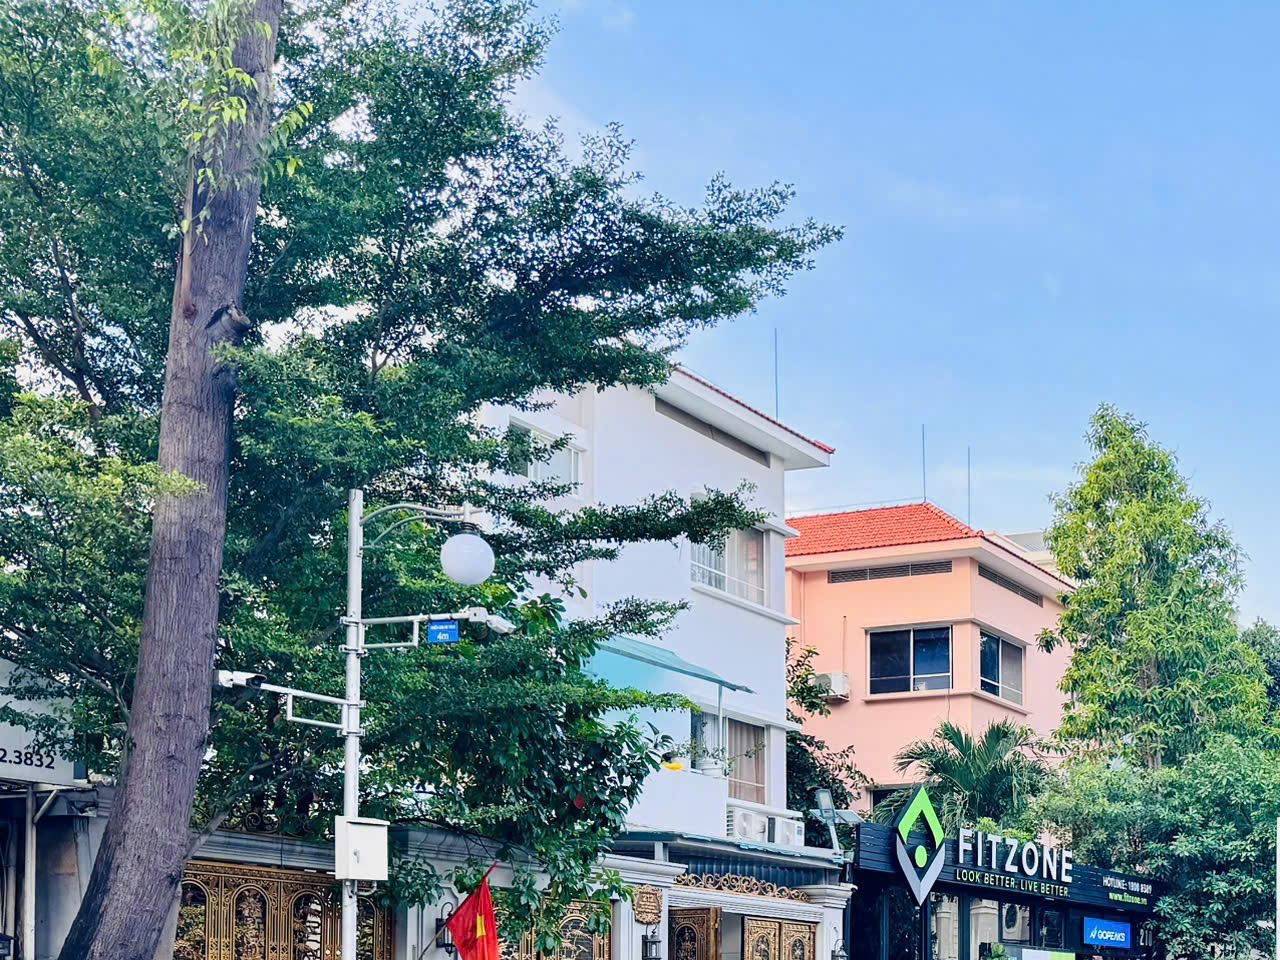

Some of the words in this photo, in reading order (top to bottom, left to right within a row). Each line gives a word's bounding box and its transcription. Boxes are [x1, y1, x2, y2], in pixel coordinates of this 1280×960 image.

[0, 747, 55, 770] 2.3832
[958, 827, 1073, 884] FITZONE
[956, 868, 981, 883] LOOK
[983, 872, 1018, 889] BETTER.
[1020, 879, 1038, 892] LIVE
